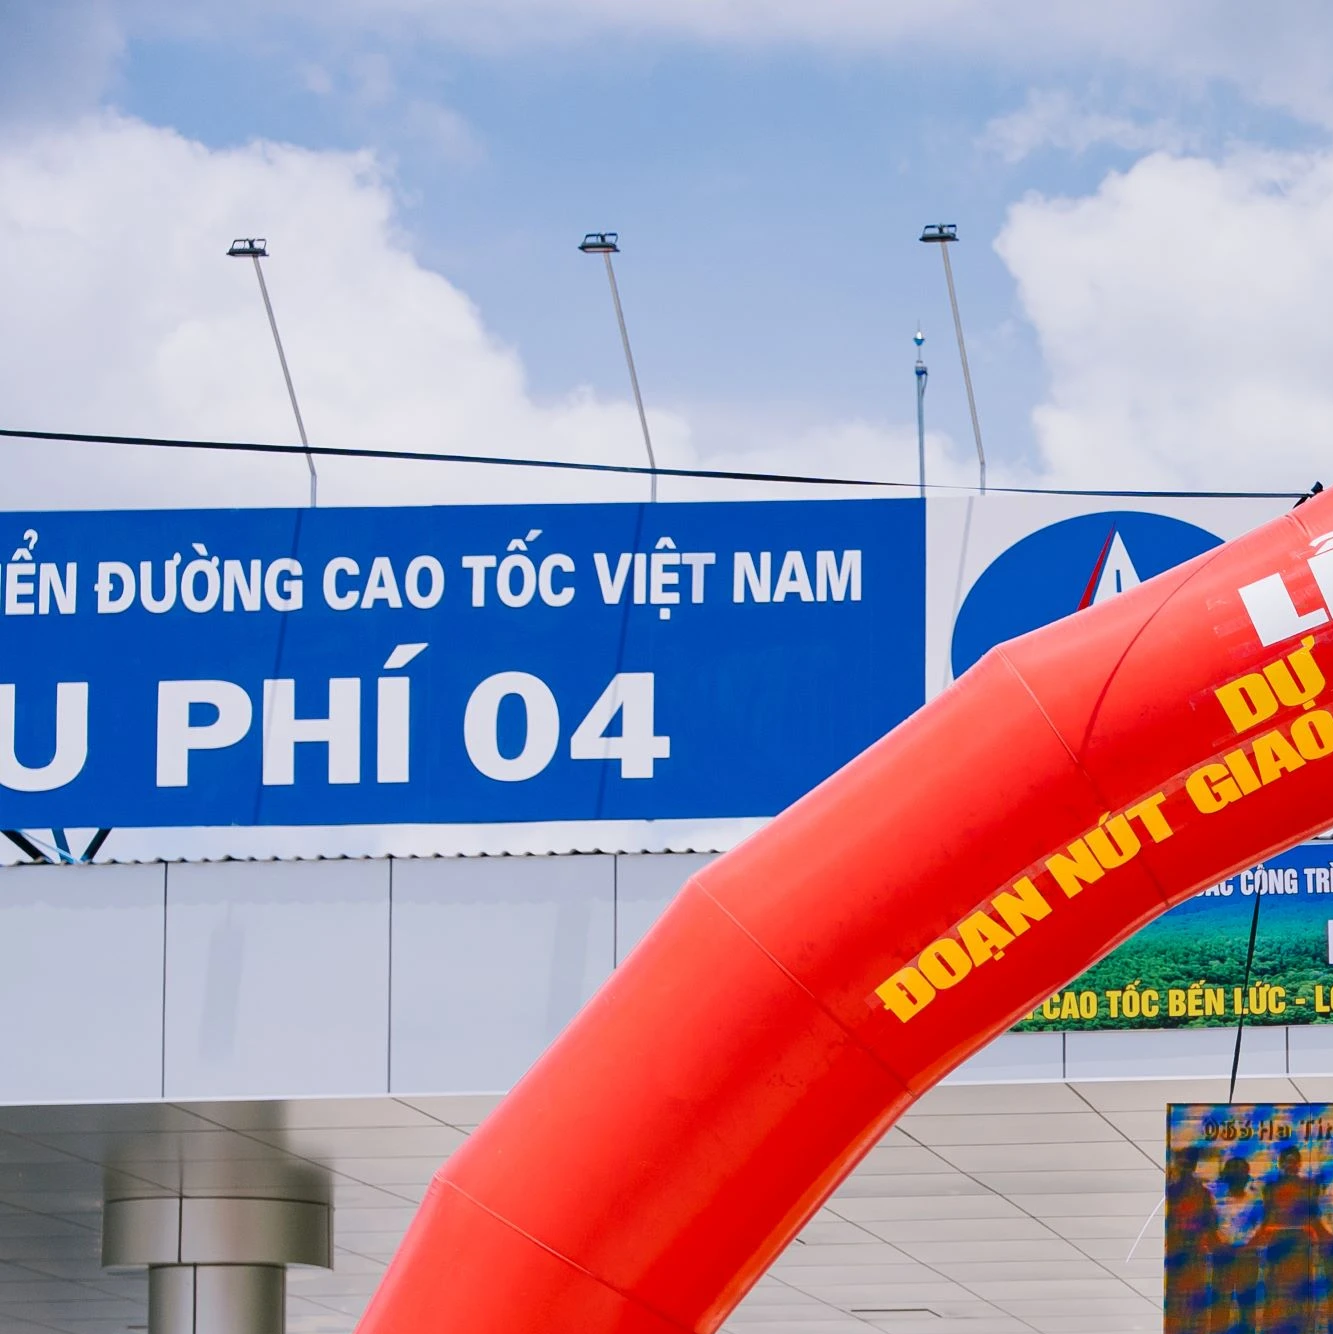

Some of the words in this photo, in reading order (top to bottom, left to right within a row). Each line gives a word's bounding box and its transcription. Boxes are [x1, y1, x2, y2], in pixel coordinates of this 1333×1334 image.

[0, 528, 78, 616] ỂN
[94, 543, 303, 615] ĐƯỜNG
[322, 555, 445, 611] CAO
[462, 529, 576, 609] TỐC
[594, 537, 716, 620] VIỆT
[733, 549, 862, 603] NAM
[156, 642, 428, 788] PHÍ
[463, 671, 671, 783] 04
[1214, 634, 1326, 734] DỰ
[874, 876, 1052, 1023] ĐOẠN
[1044, 791, 1174, 898] NÚT
[1240, 863, 1298, 896] CÔNG
[1042, 990, 1098, 1020] CAO
[1106, 979, 1160, 1018] TỐC
[1168, 979, 1225, 1017] BẾN
[1234, 982, 1287, 1016] LỨC
